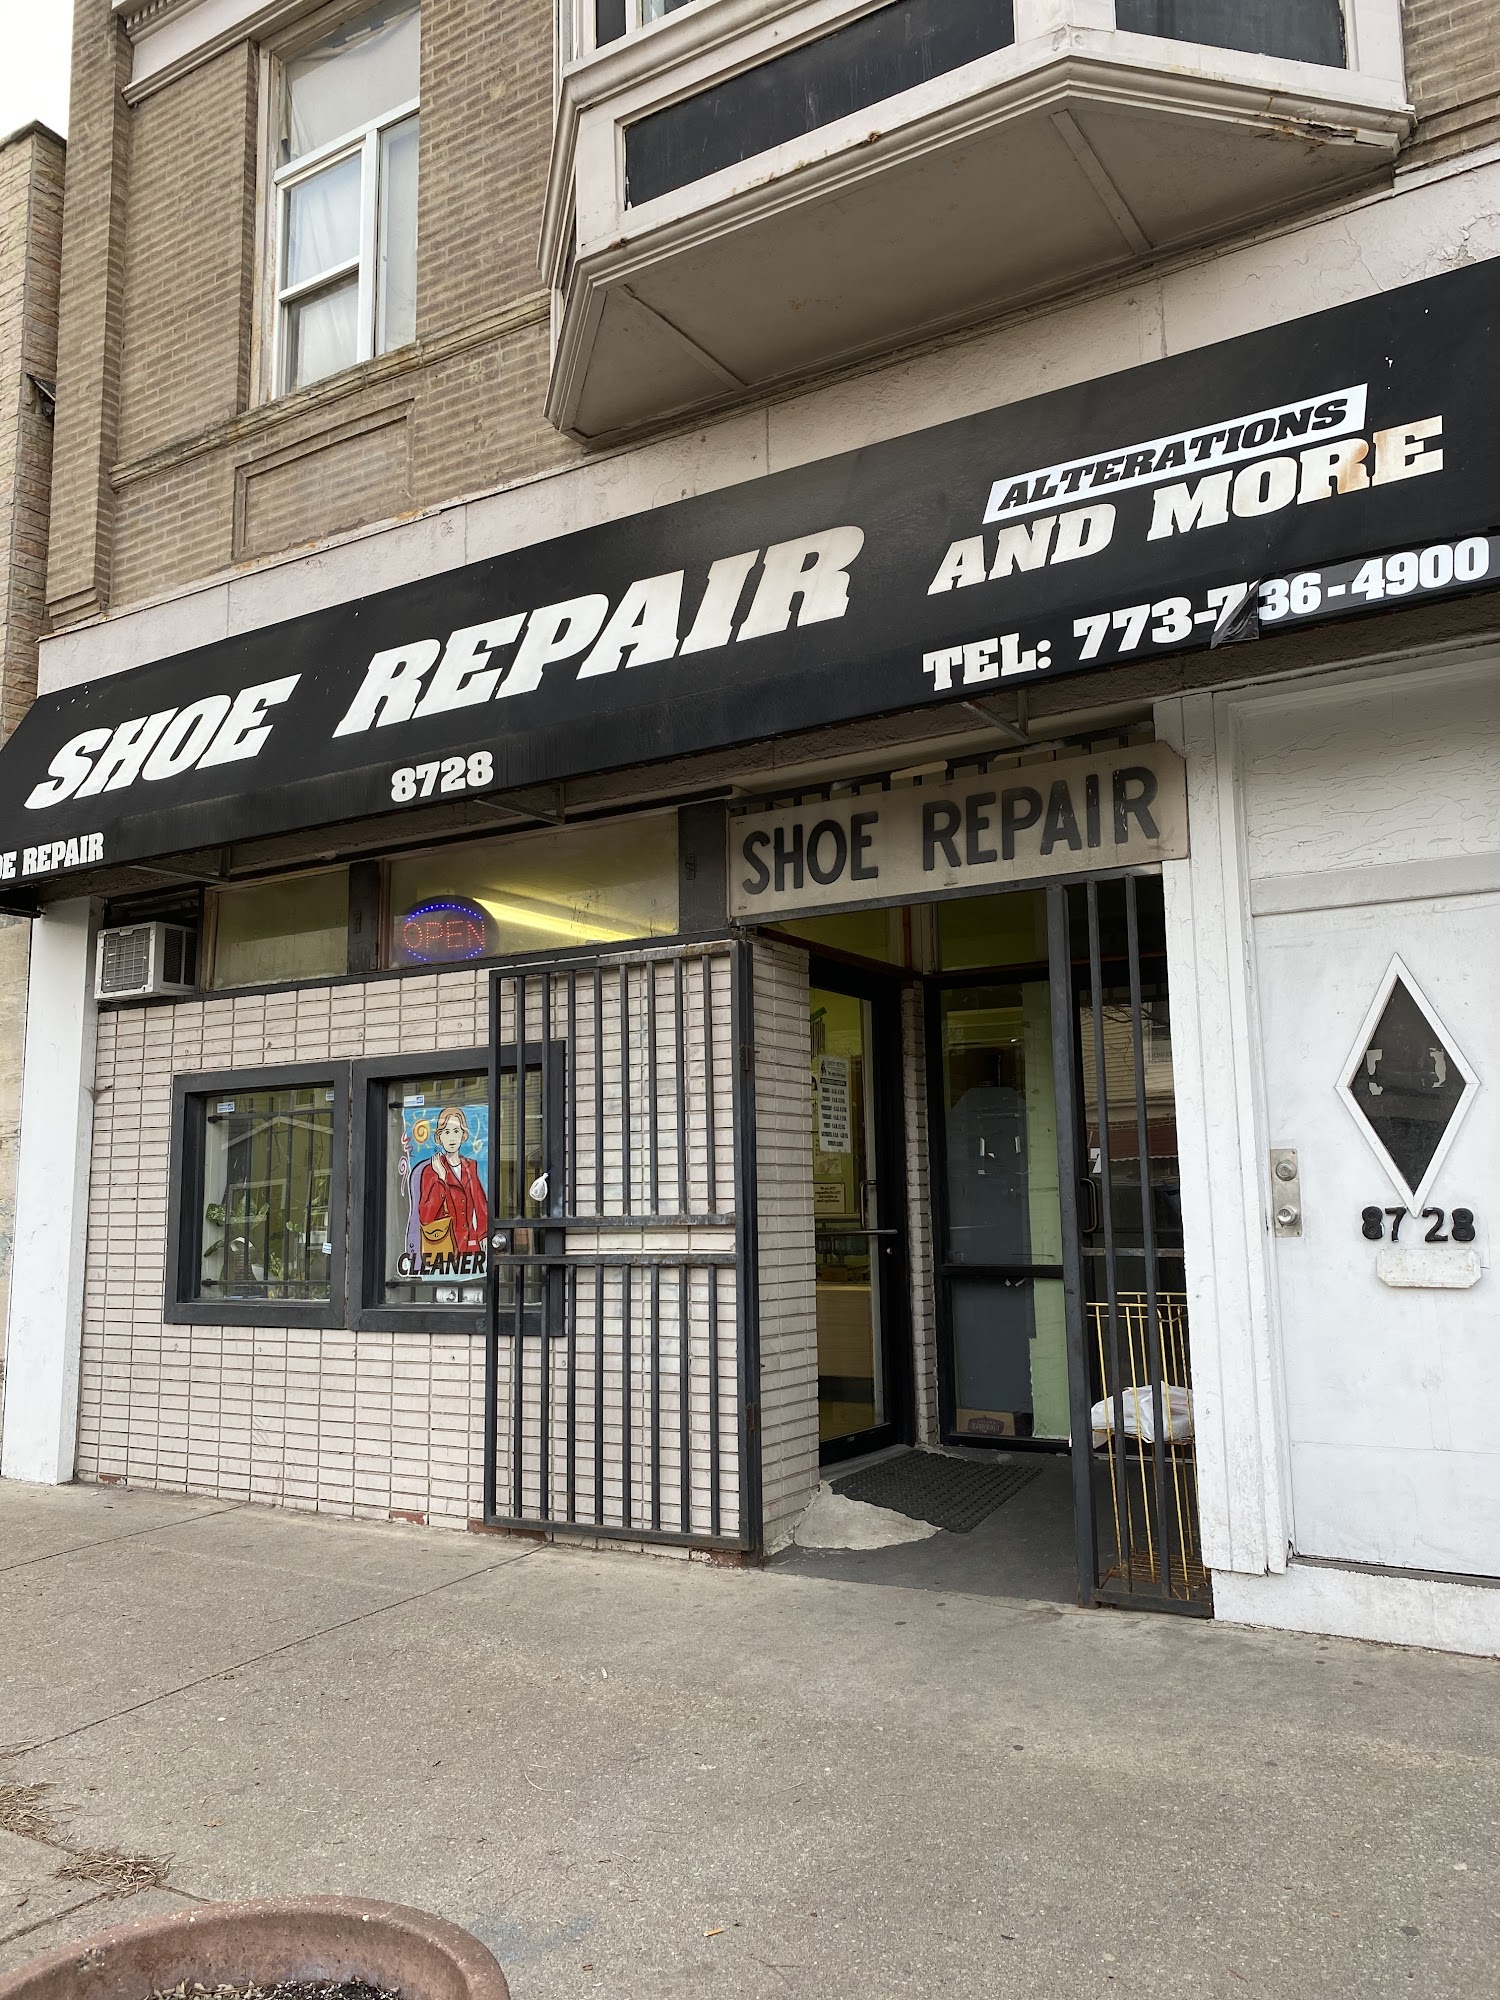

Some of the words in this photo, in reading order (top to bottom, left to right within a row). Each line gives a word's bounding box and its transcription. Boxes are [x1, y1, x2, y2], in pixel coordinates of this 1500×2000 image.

[997, 398, 1349, 512] ALTERATIONS
[927, 503, 1117, 595] AND
[1147, 415, 1444, 541] MORE
[24, 674, 302, 809] SHOE
[332, 526, 865, 738] REPAIR
[922, 633, 1052, 692] TEL:
[390, 751, 494, 803] 8728
[22, 832, 104, 876] REPAIR
[742, 811, 879, 895] SHOE
[923, 766, 1160, 871] REPAIR
[403, 920, 486, 948] OPEN
[1361, 1205, 1476, 1243] 8728
[397, 1250, 488, 1276] CLEANER
